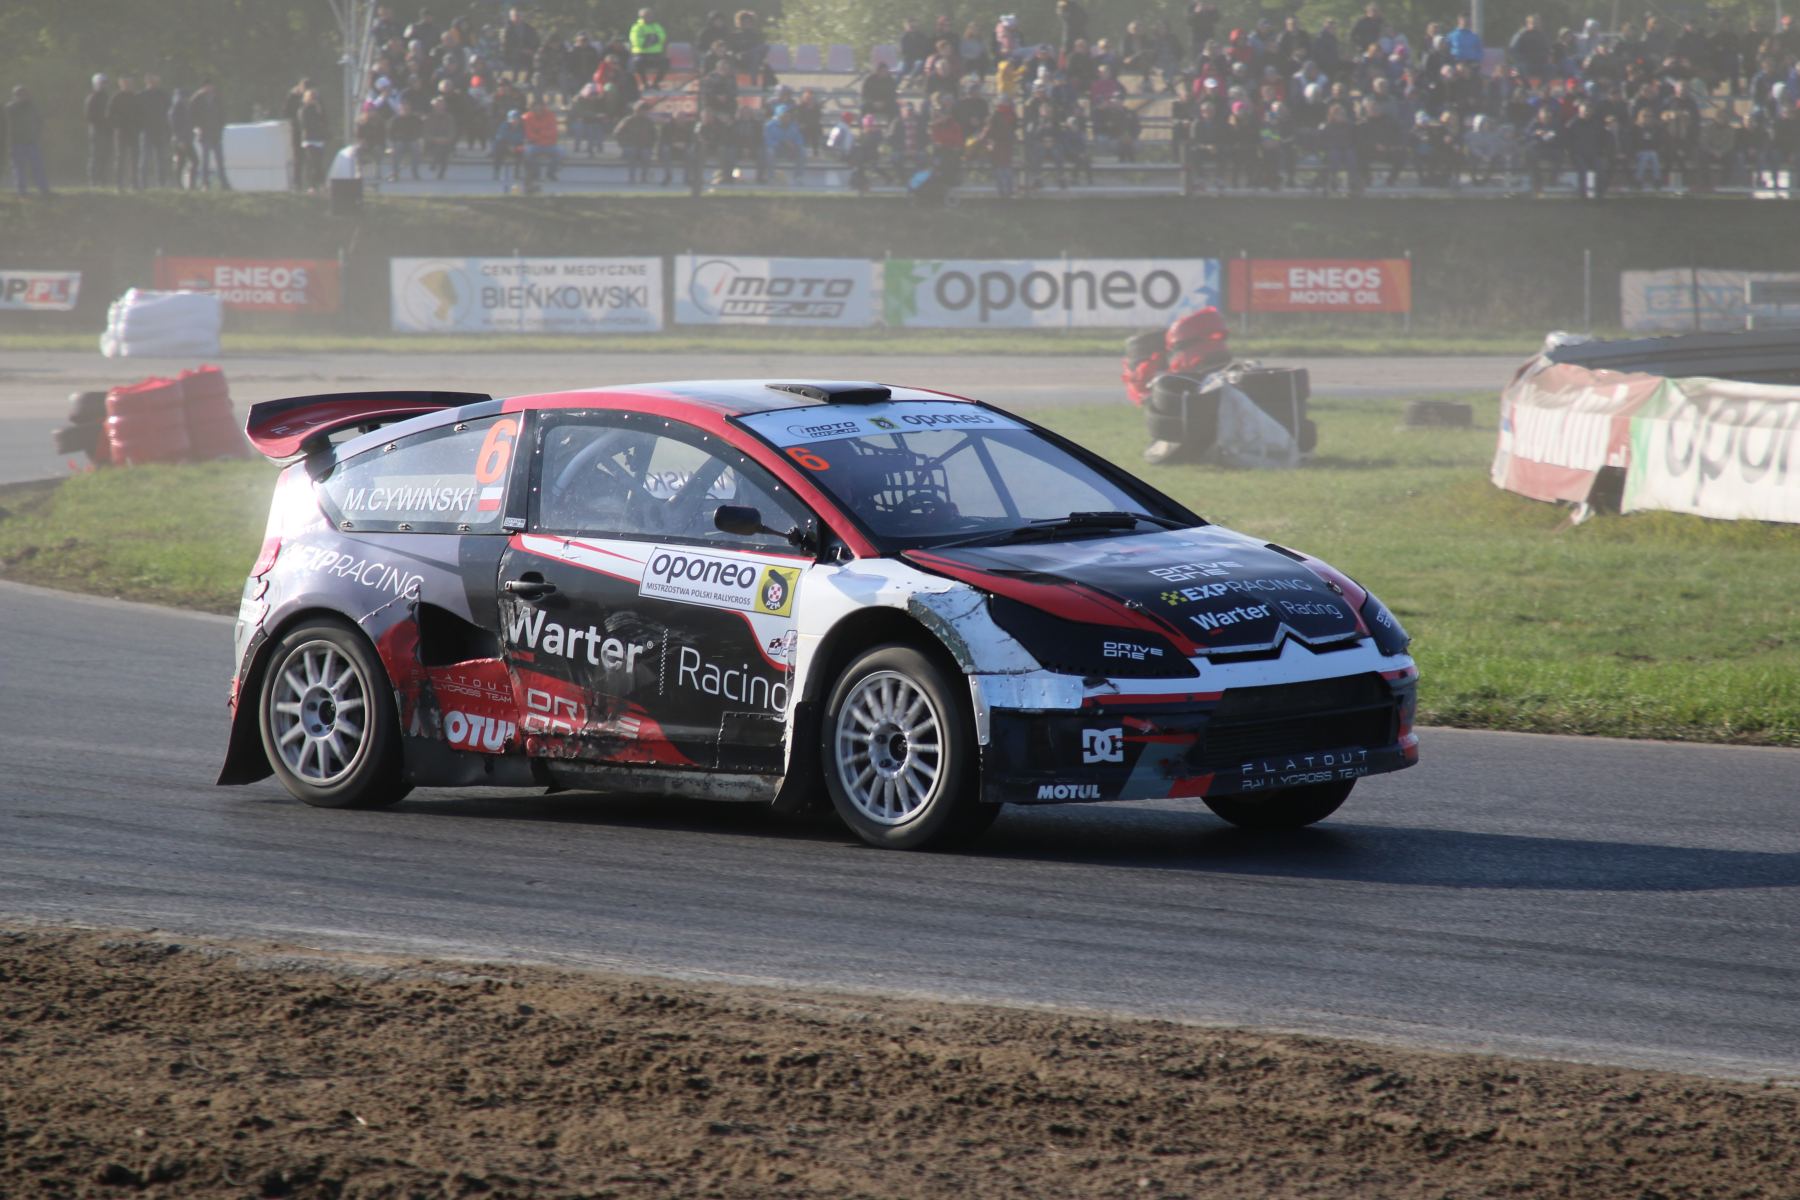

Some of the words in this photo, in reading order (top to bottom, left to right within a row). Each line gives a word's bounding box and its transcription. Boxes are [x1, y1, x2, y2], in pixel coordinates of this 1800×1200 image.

[213, 265, 308, 288] ENEOS
[481, 265, 556, 276] CENTRUM
[564, 265, 647, 276] MEDYCZNE
[1288, 267, 1381, 288] ENEOS
[281, 290, 308, 304] OIL
[481, 283, 649, 309] BIEŃKOWSKI
[728, 277, 853, 298] MOTO
[935, 268, 1181, 322] oponeo
[1289, 291, 1349, 304] MOTOR
[1354, 291, 1381, 304] OIL
[805, 421, 855, 433] MOTO
[902, 414, 994, 427] oponeo
[476, 419, 517, 484] 6
[785, 447, 830, 471] 6
[652, 554, 756, 589] oponeo
[1148, 561, 1244, 576] DRIVE
[646, 582, 690, 596] MISTRZOSTWA
[691, 588, 712, 599] POLSKI
[713, 592, 751, 606] RALLYCROSS
[1180, 579, 1313, 602] EXPRACING
[1190, 604, 1270, 630] Warter
[1280, 600, 1344, 619] Racing
[1104, 641, 1163, 657] DRIVE
[486, 691, 512, 703] TEAM
[1241, 750, 1367, 774] FLATOUT
[1037, 784, 1101, 799] MOTUL
